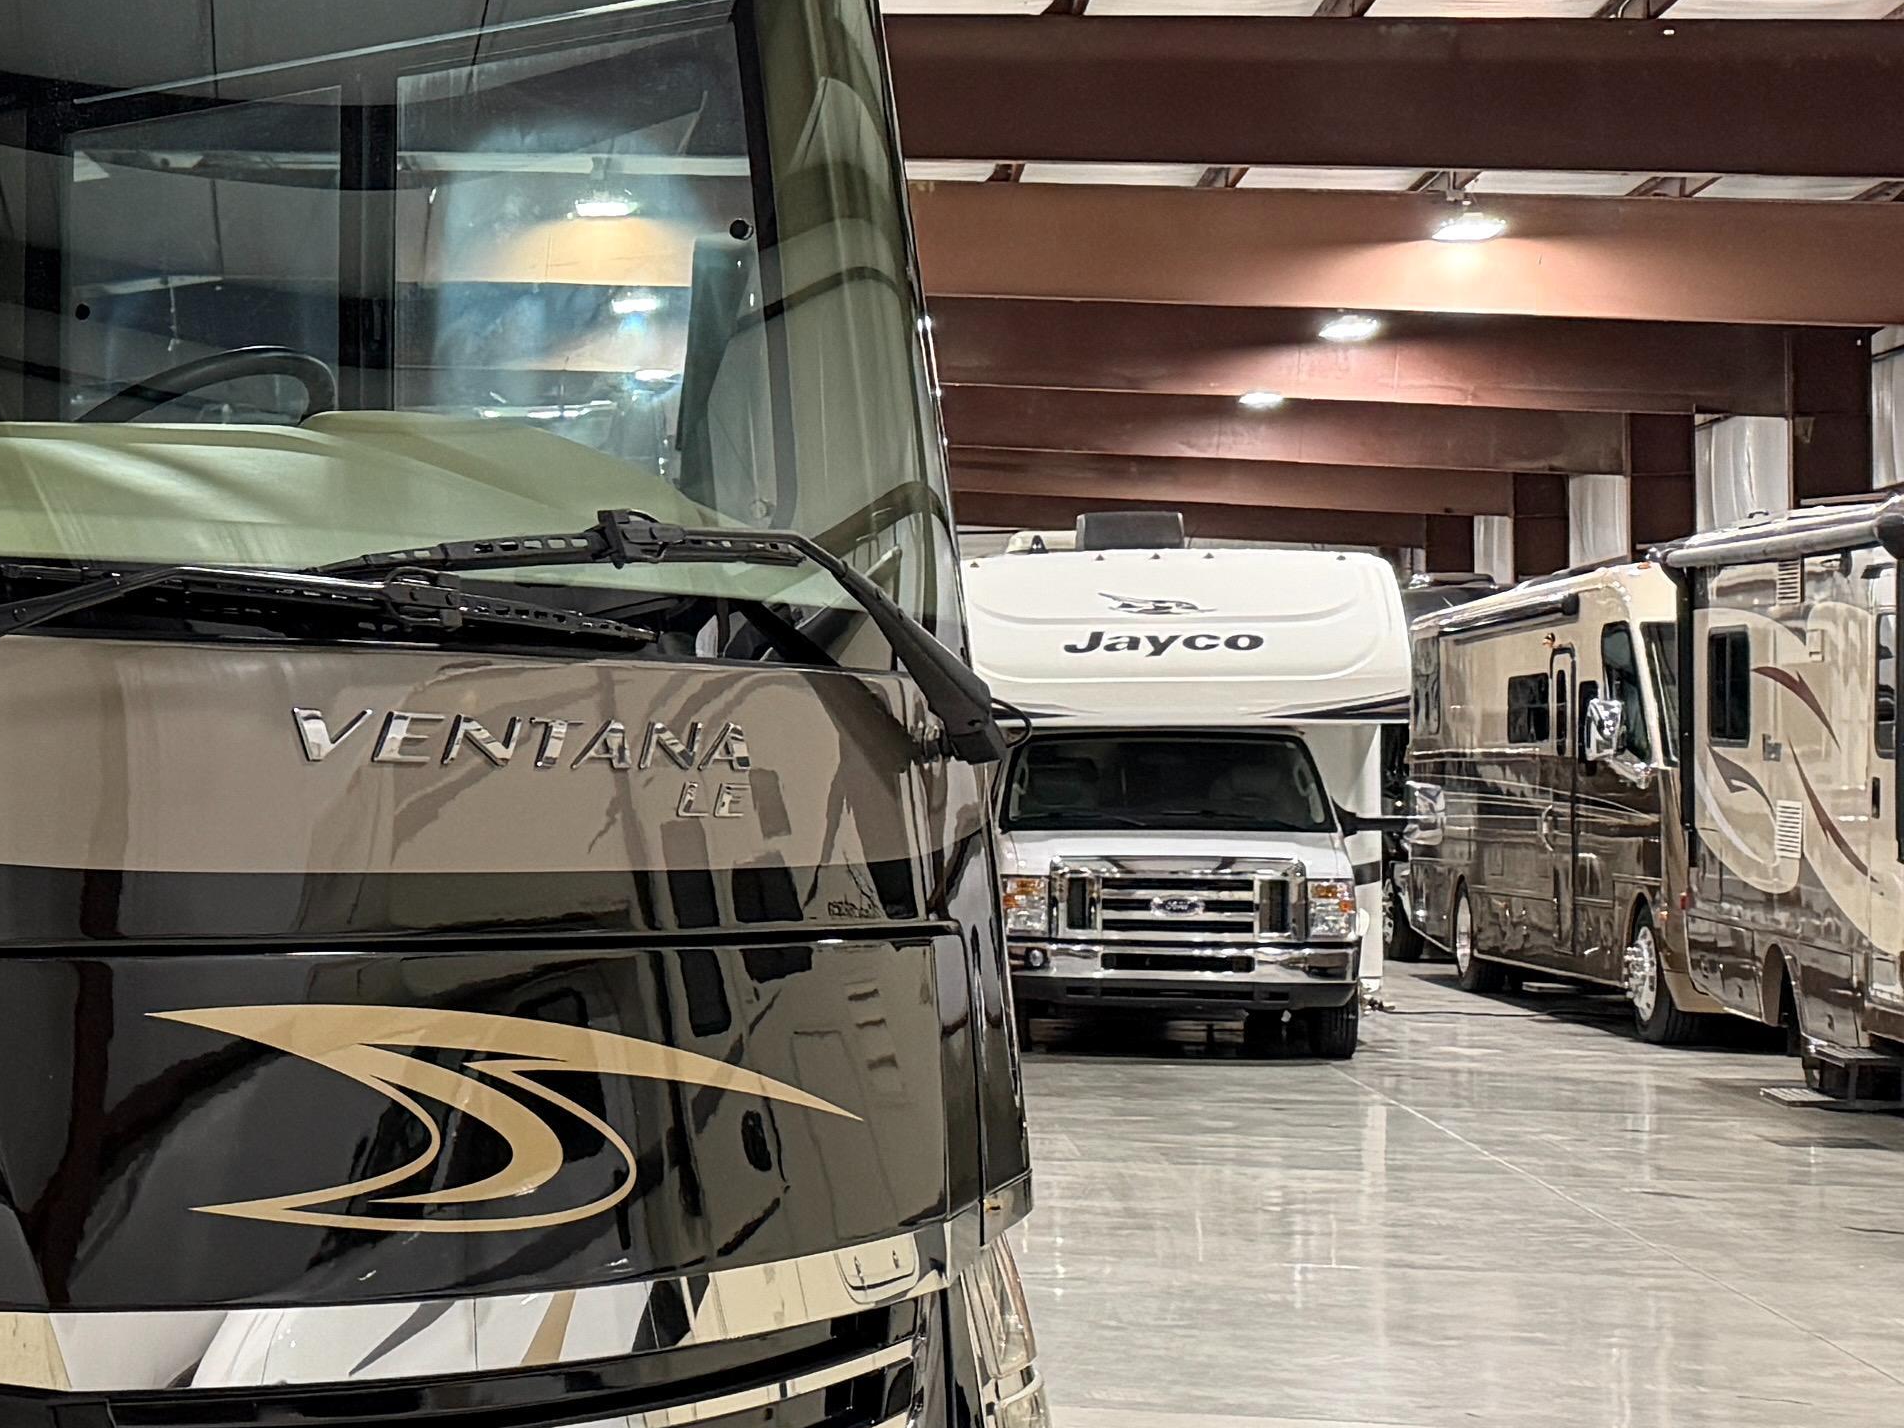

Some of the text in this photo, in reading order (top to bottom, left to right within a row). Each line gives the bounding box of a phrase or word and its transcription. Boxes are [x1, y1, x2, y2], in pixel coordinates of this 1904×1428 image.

[1064, 629, 1265, 658] Jayco
[292, 707, 752, 771] VENTANA
[676, 780, 751, 818] LE
